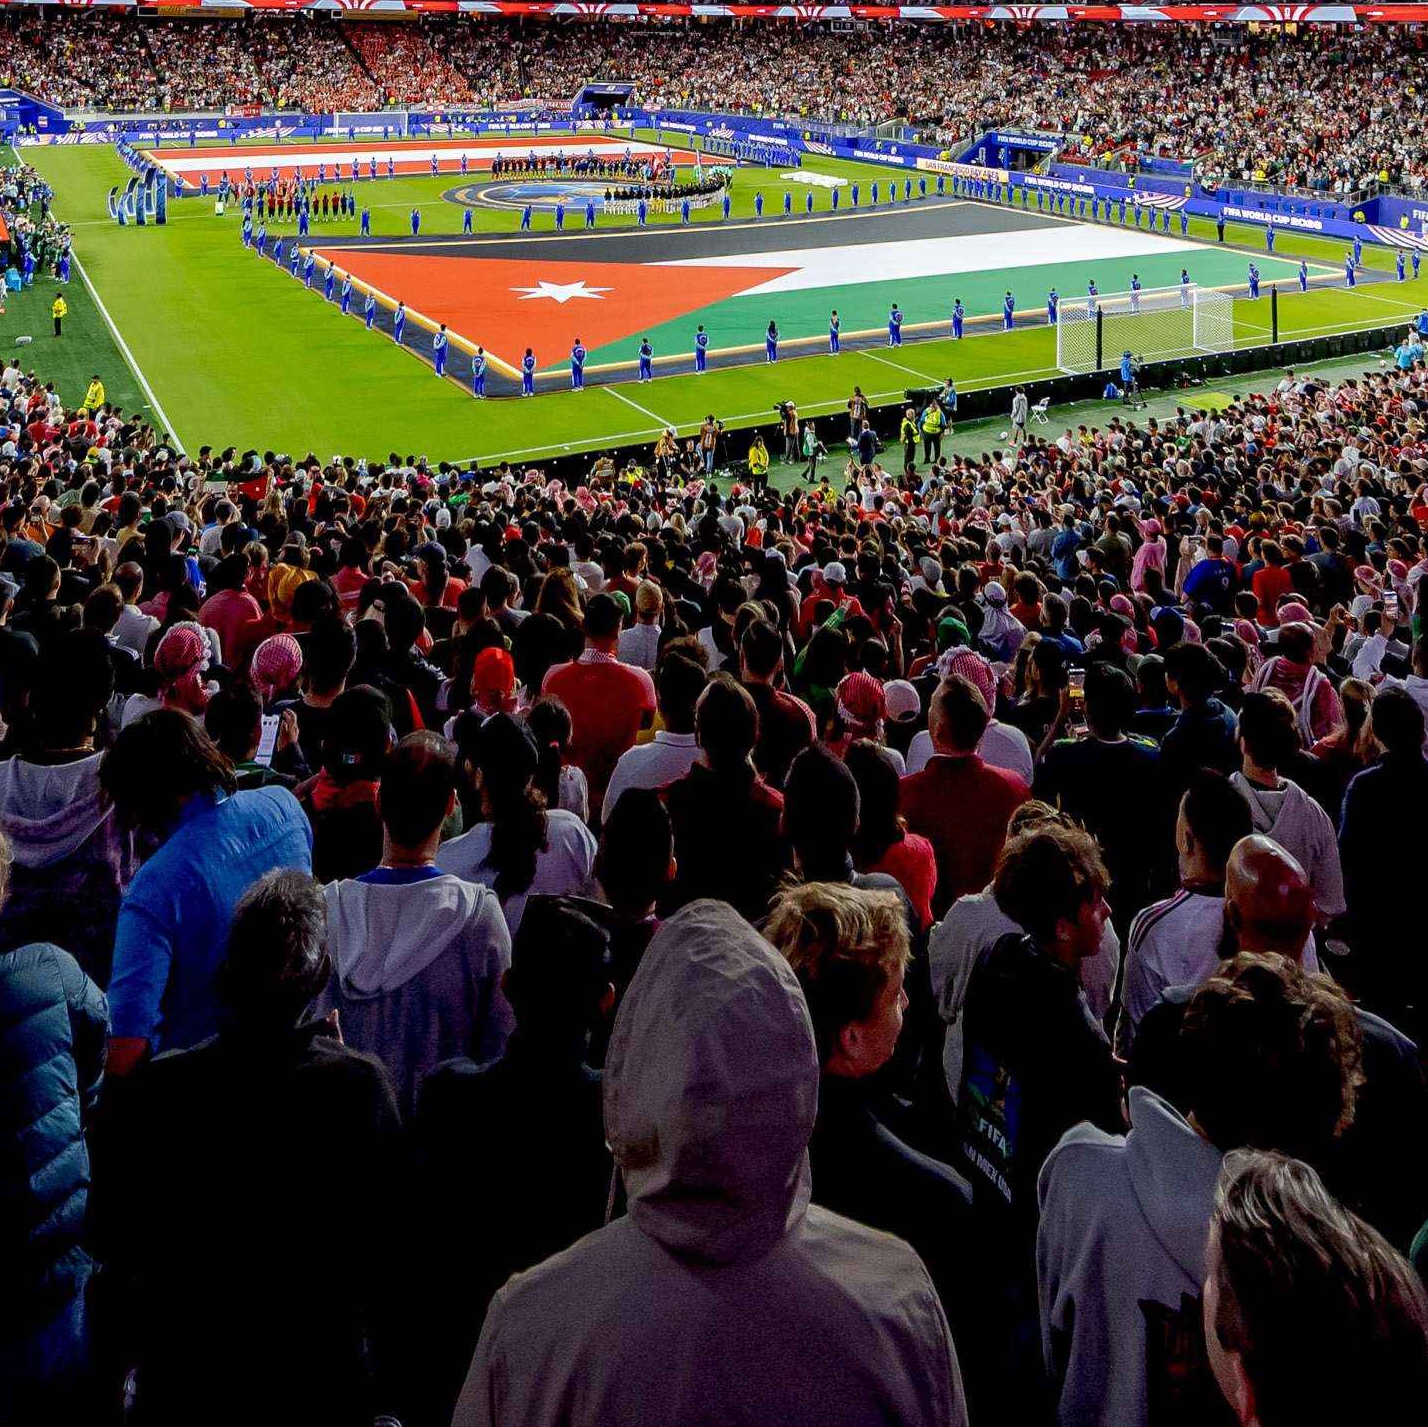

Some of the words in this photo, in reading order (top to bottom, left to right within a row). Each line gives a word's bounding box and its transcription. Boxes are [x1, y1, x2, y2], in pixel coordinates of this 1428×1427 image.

[1008, 136, 1026, 145] WORLD
[1027, 138, 1037, 146] CUP
[1224, 206, 1240, 217] FIFA
[1241, 208, 1271, 222] WORLD
[1273, 213, 1289, 225] CUP
[977, 1118, 1006, 1160] FIFA
